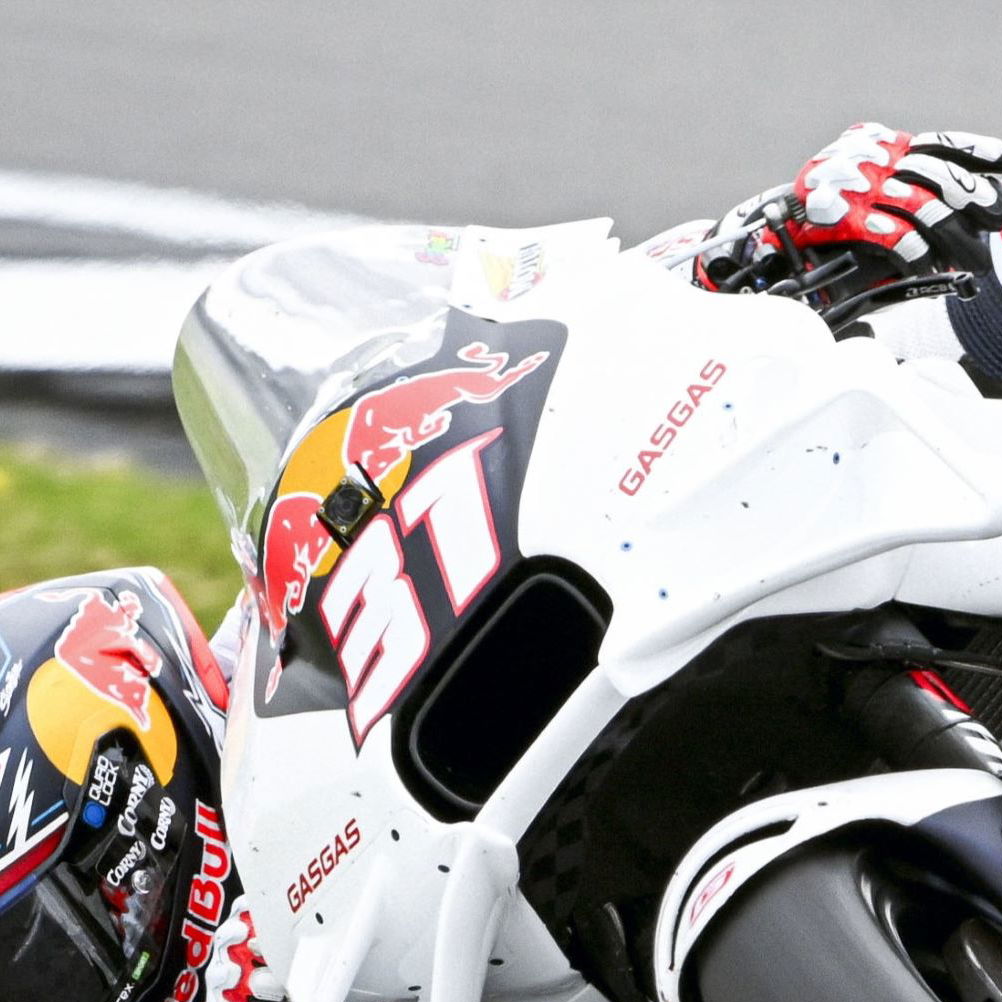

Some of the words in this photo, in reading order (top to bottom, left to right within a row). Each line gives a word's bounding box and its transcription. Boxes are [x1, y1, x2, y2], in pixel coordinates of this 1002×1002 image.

[618, 359, 727, 497] GASGAS
[318, 427, 503, 748] 31
[89, 755, 110, 801] QUAD
[99, 760, 120, 806] LOCK
[117, 764, 155, 837] CORNY
[286, 819, 361, 913] GASGAS
